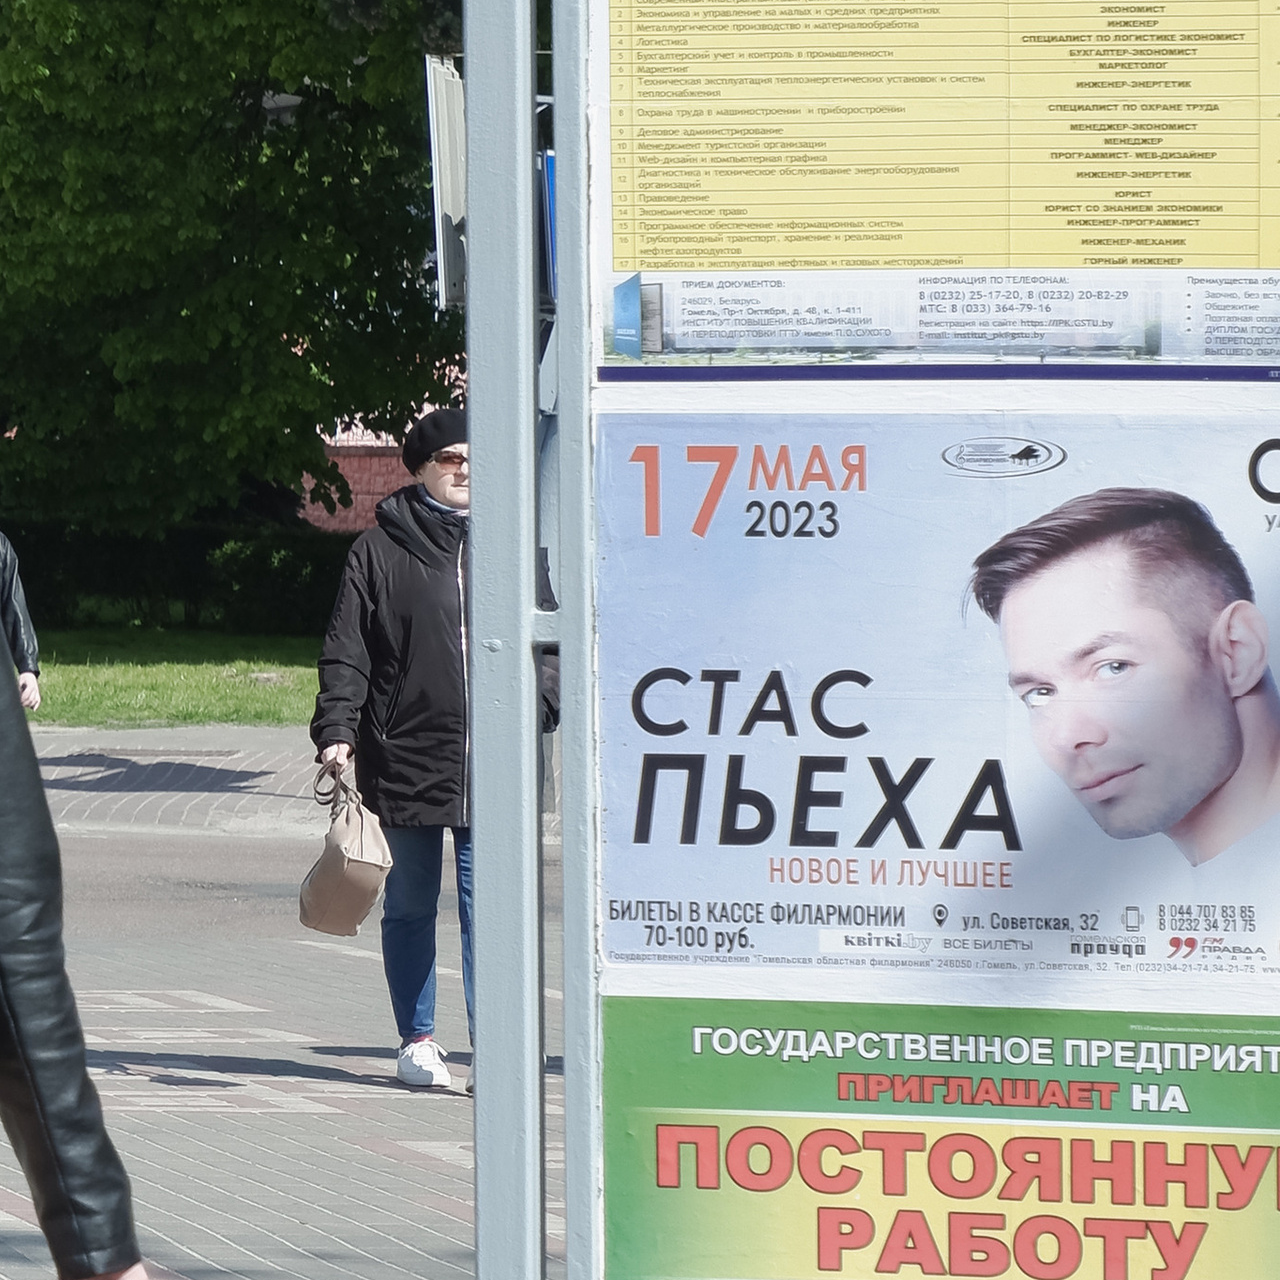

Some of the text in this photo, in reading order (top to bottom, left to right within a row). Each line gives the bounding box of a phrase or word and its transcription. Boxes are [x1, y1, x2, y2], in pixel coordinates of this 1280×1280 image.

[1100, 5, 1166, 14] ЭКОНОМИСТ
[1098, 61, 1168, 70] МАРКЕТОЛОГ
[918, 276, 987, 286] ИНФОРМАЦИЯ
[990, 276, 1003, 284] ПО
[919, 291, 925, 300] 8
[929, 290, 966, 301] (0232)
[1027, 291, 1034, 299] 8
[1038, 290, 1075, 301] (0232)
[1078, 290, 1129, 300] 20-82-29
[919, 304, 1052, 314] МТС: 8 (033) 364-79-16
[628, 444, 868, 539] 17 МАЯ
[744, 500, 841, 539] 2023
[631, 667, 874, 740] СТАС
[632, 752, 1024, 851] ПЬЕХА
[770, 857, 1014, 889] НОВОЕ И ЛУЧШЕЕ
[609, 899, 906, 927] БИЛЕТЫ В КАССЕ ФИЛАРМОНИИ
[962, 912, 1100, 933] ул. Советская, 32
[1158, 905, 1255, 919] 8 044 707 83 85
[1158, 919, 1256, 932] 8 0232 34 21 75
[644, 925, 755, 953] 70-100 руб.
[943, 938, 970, 950] ВСЕ
[973, 938, 1033, 951] БИЛЕТЫ
[1202, 946, 1266, 954] ПРАВДА
[692, 1025, 1055, 1067] ГОСУДАРСТВЕННОЕ
[837, 1072, 1189, 1114] ПРИГЛАШАЕТ НА
[655, 1123, 1280, 1212] ПОСТОЯННУ
